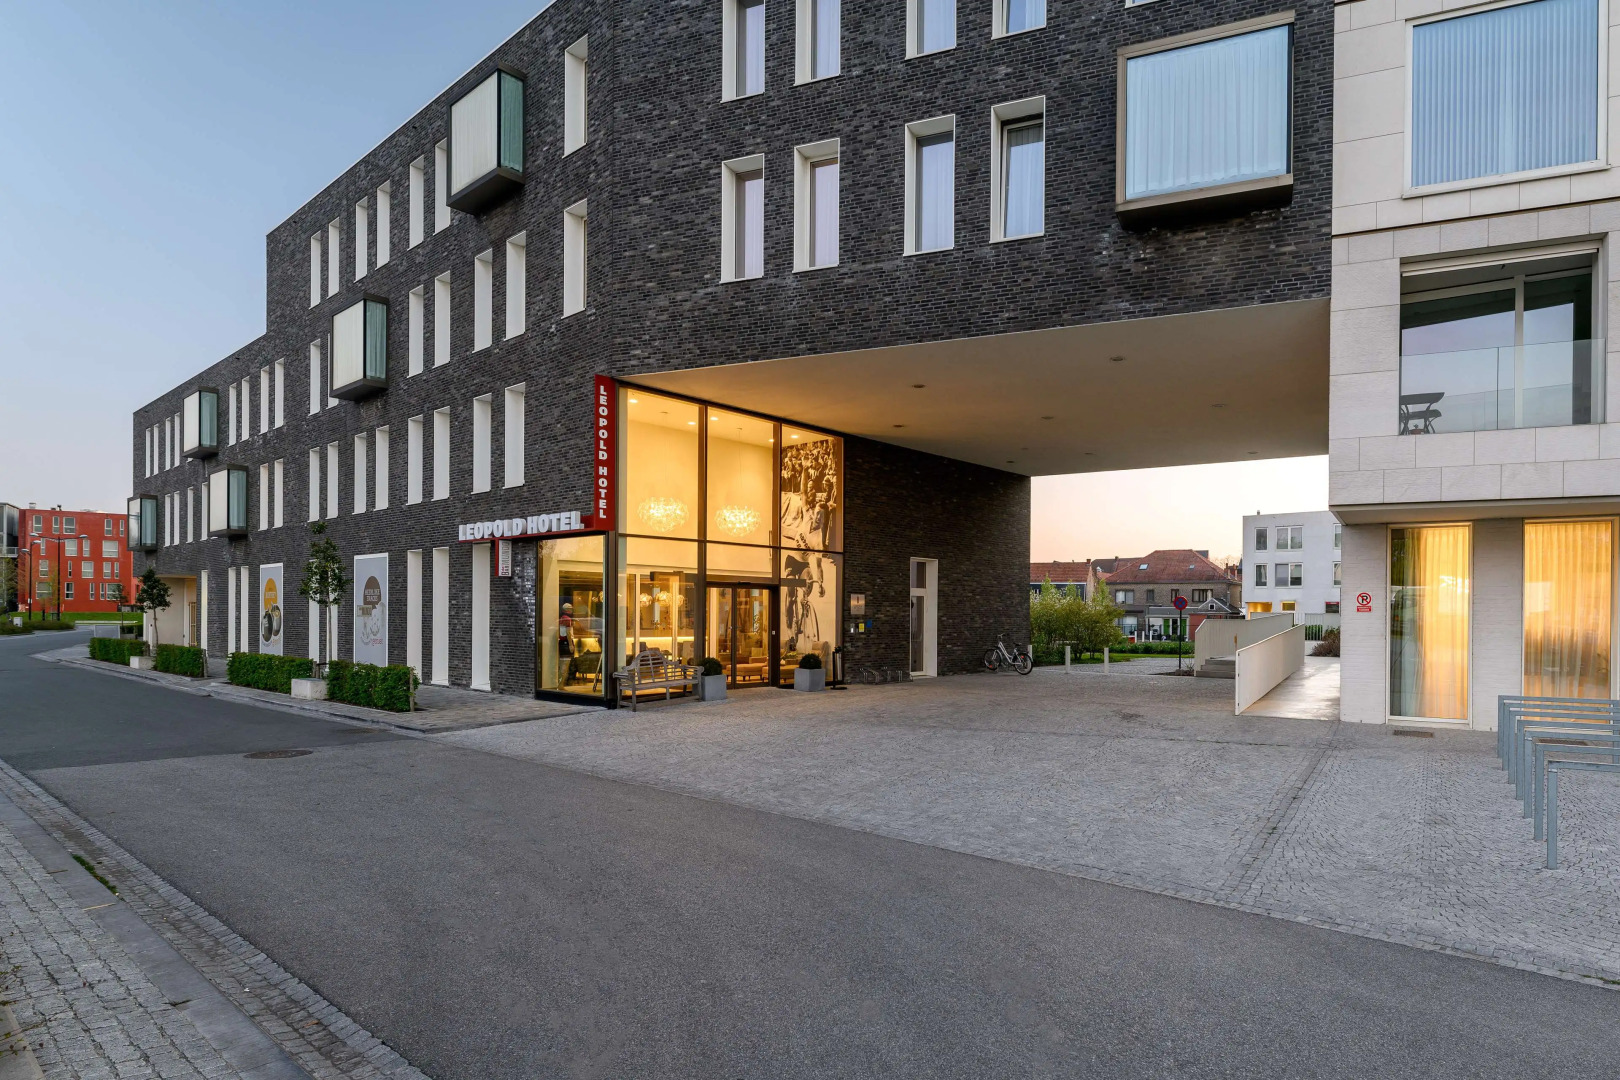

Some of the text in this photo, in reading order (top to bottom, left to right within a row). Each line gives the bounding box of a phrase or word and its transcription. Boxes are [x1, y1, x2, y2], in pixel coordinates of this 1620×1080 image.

[598, 385, 608, 519] LEOPOLD HOTEL
[459, 511, 583, 540] LEOPOLD HOTEL
